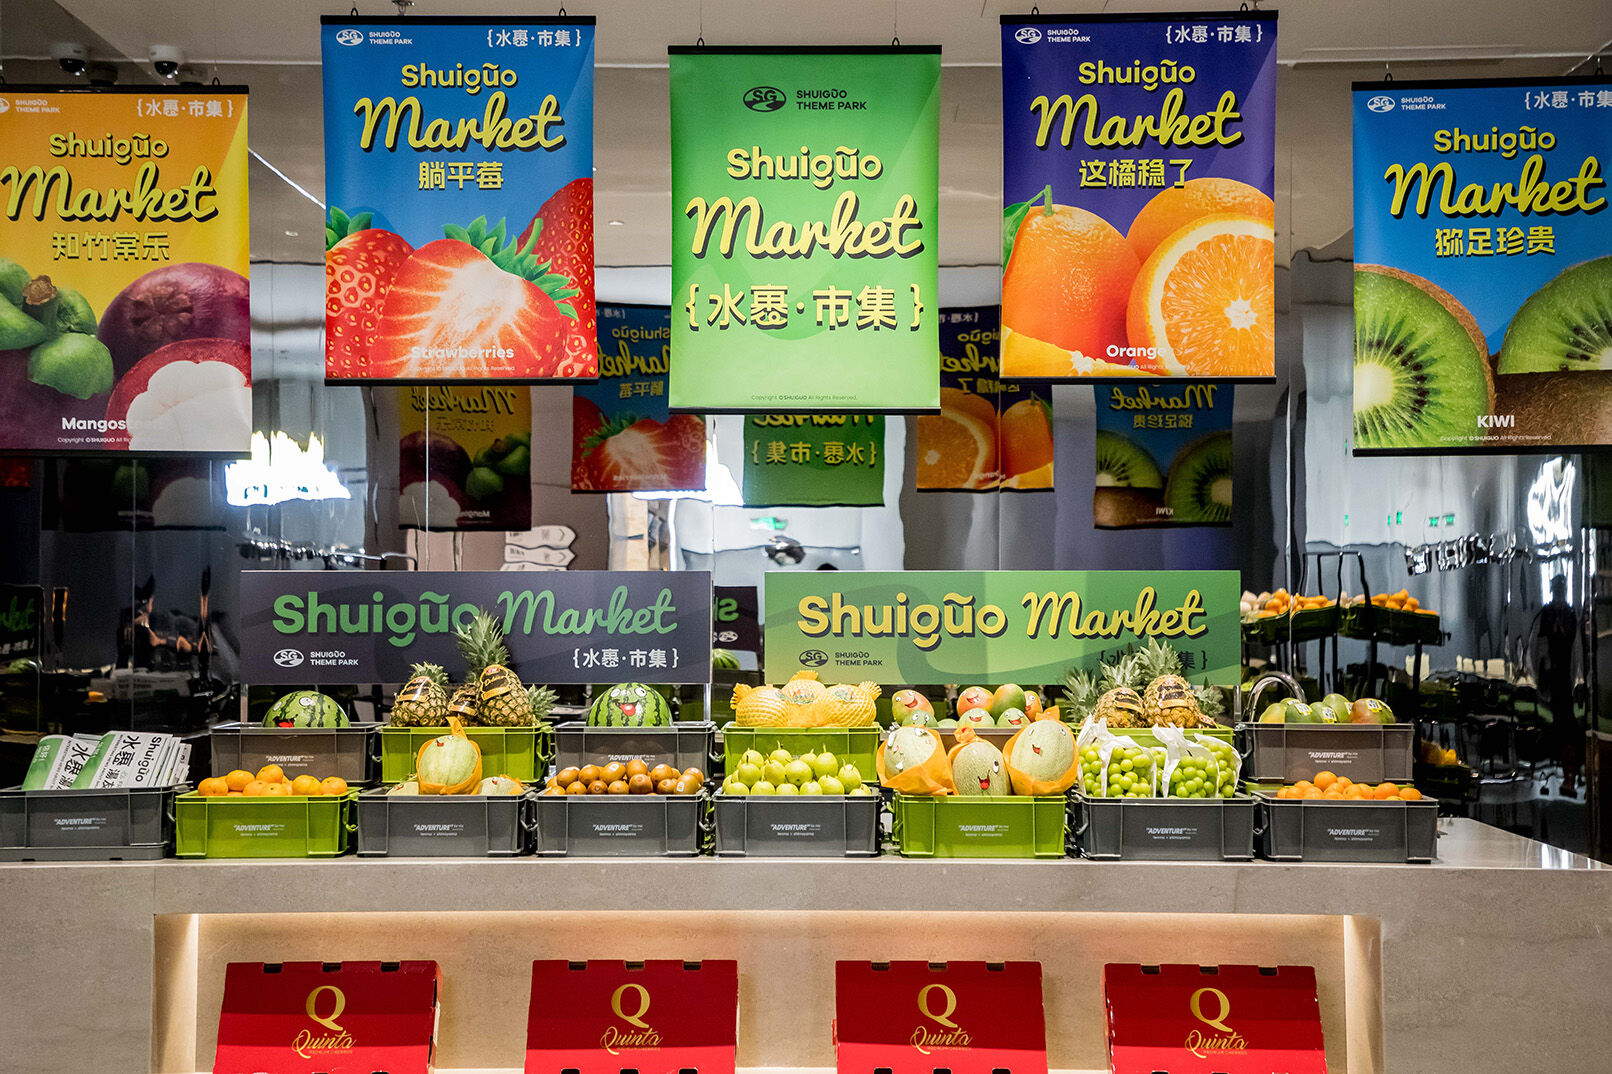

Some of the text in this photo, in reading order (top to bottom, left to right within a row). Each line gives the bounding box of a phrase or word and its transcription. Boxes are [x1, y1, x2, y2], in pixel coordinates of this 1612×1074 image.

[354, 91, 567, 153] Market
[796, 101, 867, 110] THEME PARK
[1030, 87, 1244, 149] Market
[418, 161, 504, 190] 躺平莓
[726, 146, 883, 190] Shuigũo
[1079, 159, 1192, 189] 这橘稳了
[1384, 154, 1608, 220] Market
[0, 161, 219, 222] Market
[685, 190, 925, 259] Market
[1435, 226, 1556, 258] 猕足珍贵
[53, 232, 169, 260] 知竹常乐
[411, 345, 515, 359] Strawberries
[62, 417, 127, 433] Mangos
[1477, 415, 1515, 428] KIWI
[497, 585, 678, 635] Market
[798, 592, 1008, 651] Shuigũo
[1021, 586, 1209, 640] Market
[306, 985, 346, 1031] Q
[611, 983, 650, 1028] Q
[918, 983, 958, 1028] Q
[1190, 987, 1233, 1032] Q
[292, 1029, 356, 1059] Quinta
[600, 1026, 663, 1055] Quinta
[910, 1025, 973, 1054] Quinta
[1185, 1029, 1249, 1059] Quinta
